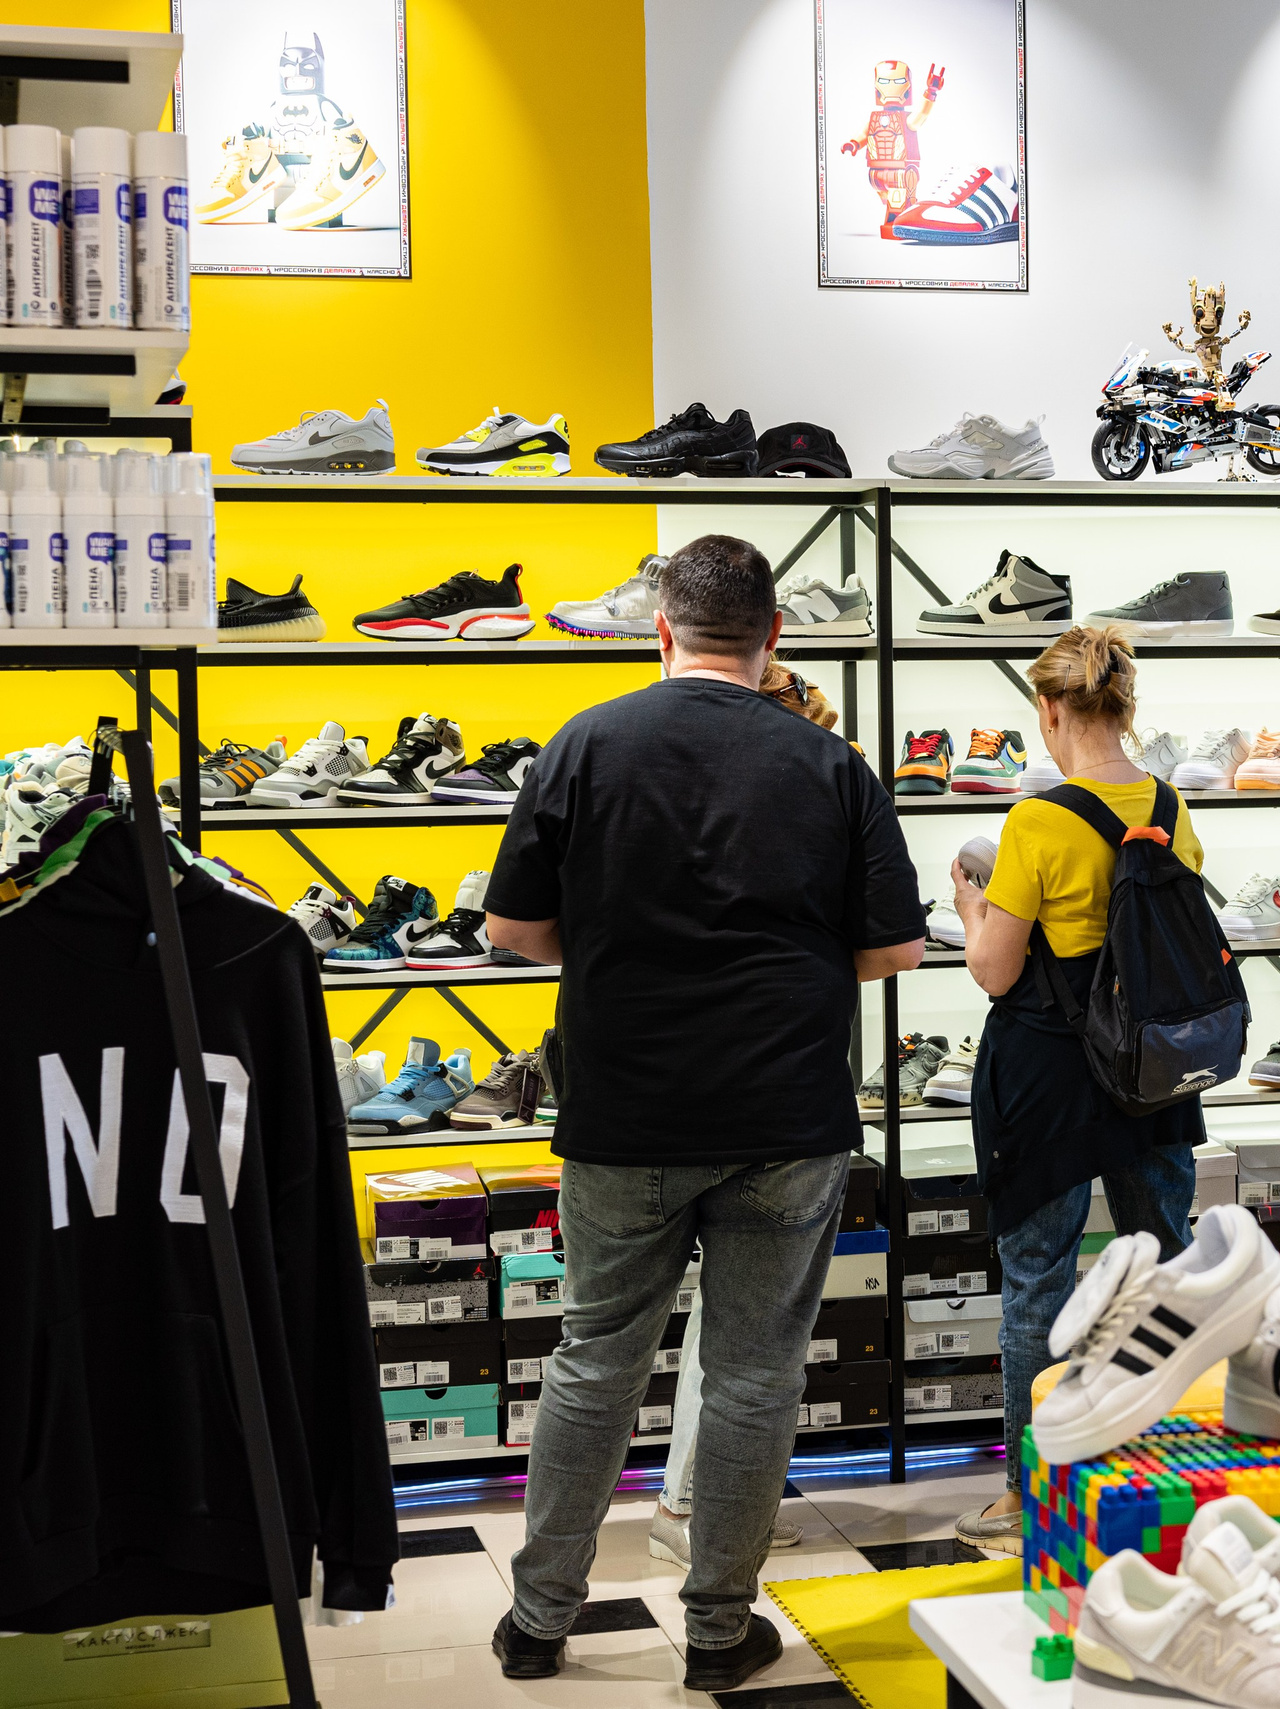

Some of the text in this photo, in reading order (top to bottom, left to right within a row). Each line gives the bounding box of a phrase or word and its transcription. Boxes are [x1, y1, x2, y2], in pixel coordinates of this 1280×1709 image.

[31, 221, 41, 298] АНТИРЕАГЕНТ
[118, 224, 127, 300] АНТИРЕАГЕНТ
[164, 227, 174, 302] АНТИРЕАГЕНТ
[88, 567, 98, 600] ПЕНА
[150, 567, 158, 600] ПЕНА
[480, 1368, 489, 1376] 23
[77, 1625, 199, 1649] КАКТУС ДЖЕК
